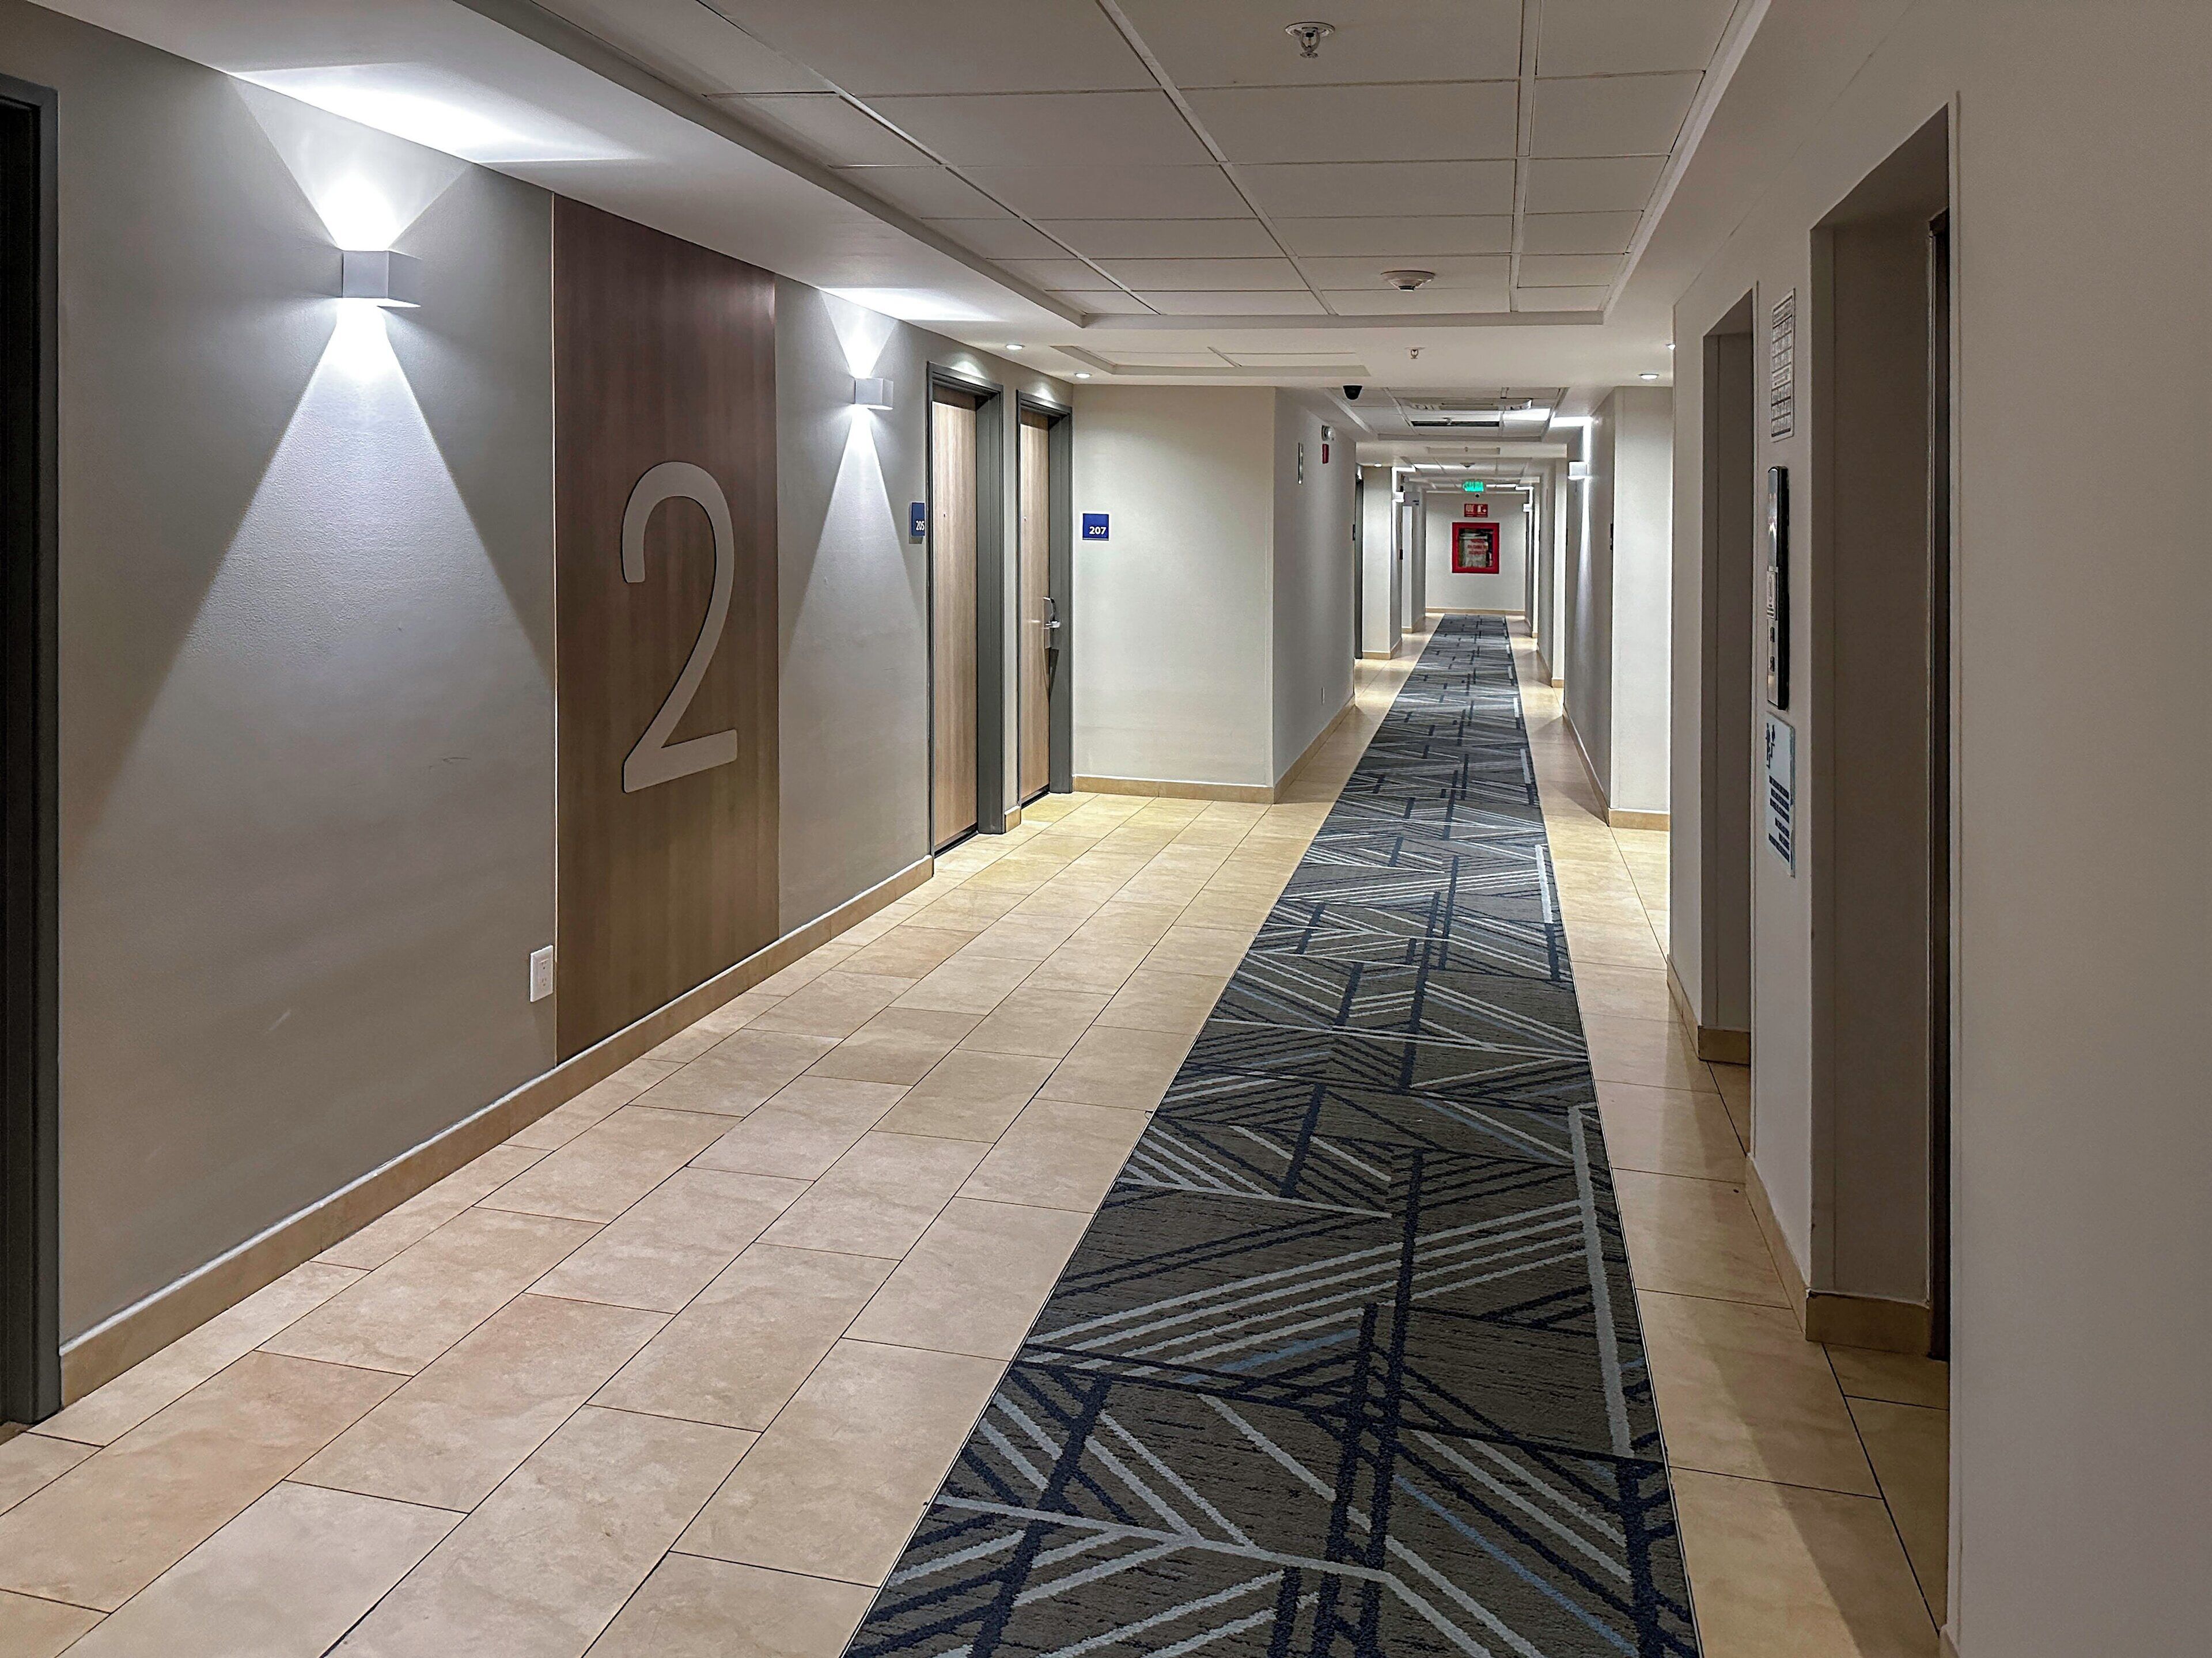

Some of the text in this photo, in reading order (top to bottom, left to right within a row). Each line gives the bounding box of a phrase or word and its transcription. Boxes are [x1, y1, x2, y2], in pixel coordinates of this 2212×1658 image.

[916, 520, 925, 531] 205
[1089, 526, 1107, 534] 207
[622, 461, 738, 793] 2
